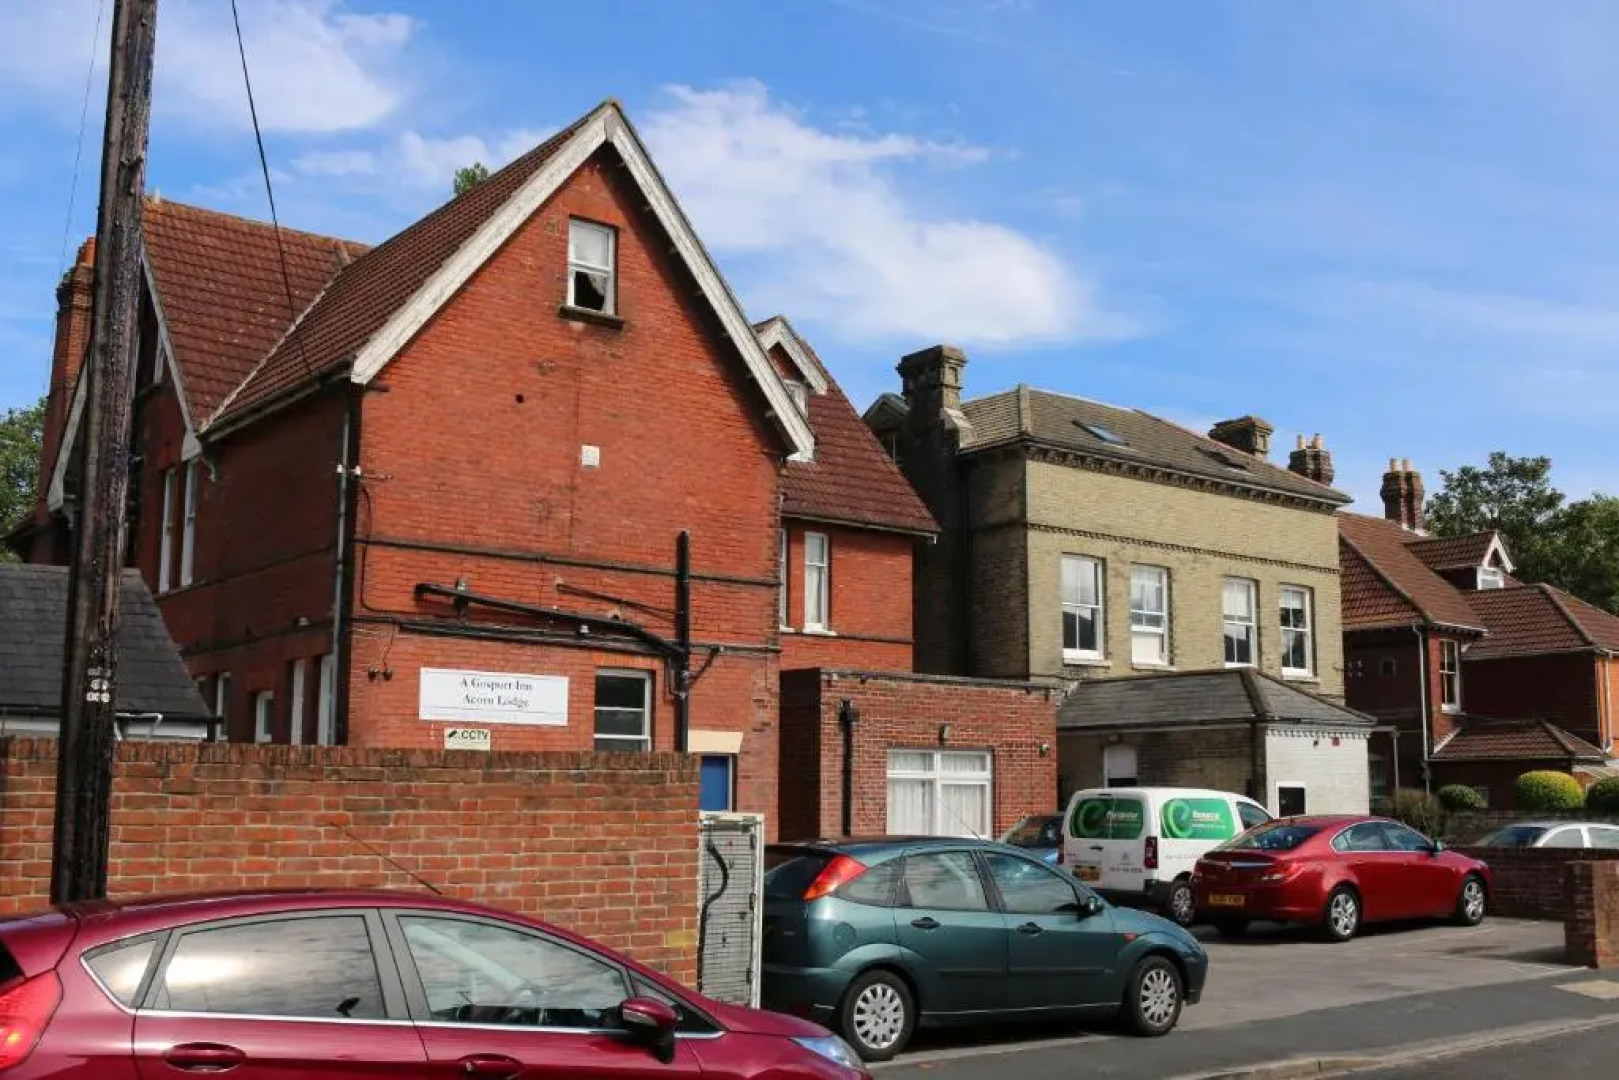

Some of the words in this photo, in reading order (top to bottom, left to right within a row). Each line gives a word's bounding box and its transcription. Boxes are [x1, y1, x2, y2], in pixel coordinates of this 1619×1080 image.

[460, 678, 468, 687] A
[471, 678, 511, 691] Gosport
[516, 681, 532, 690] Inn
[464, 694, 494, 704] Acorn
[497, 696, 529, 708] Lodge
[461, 730, 489, 740] CCTV
